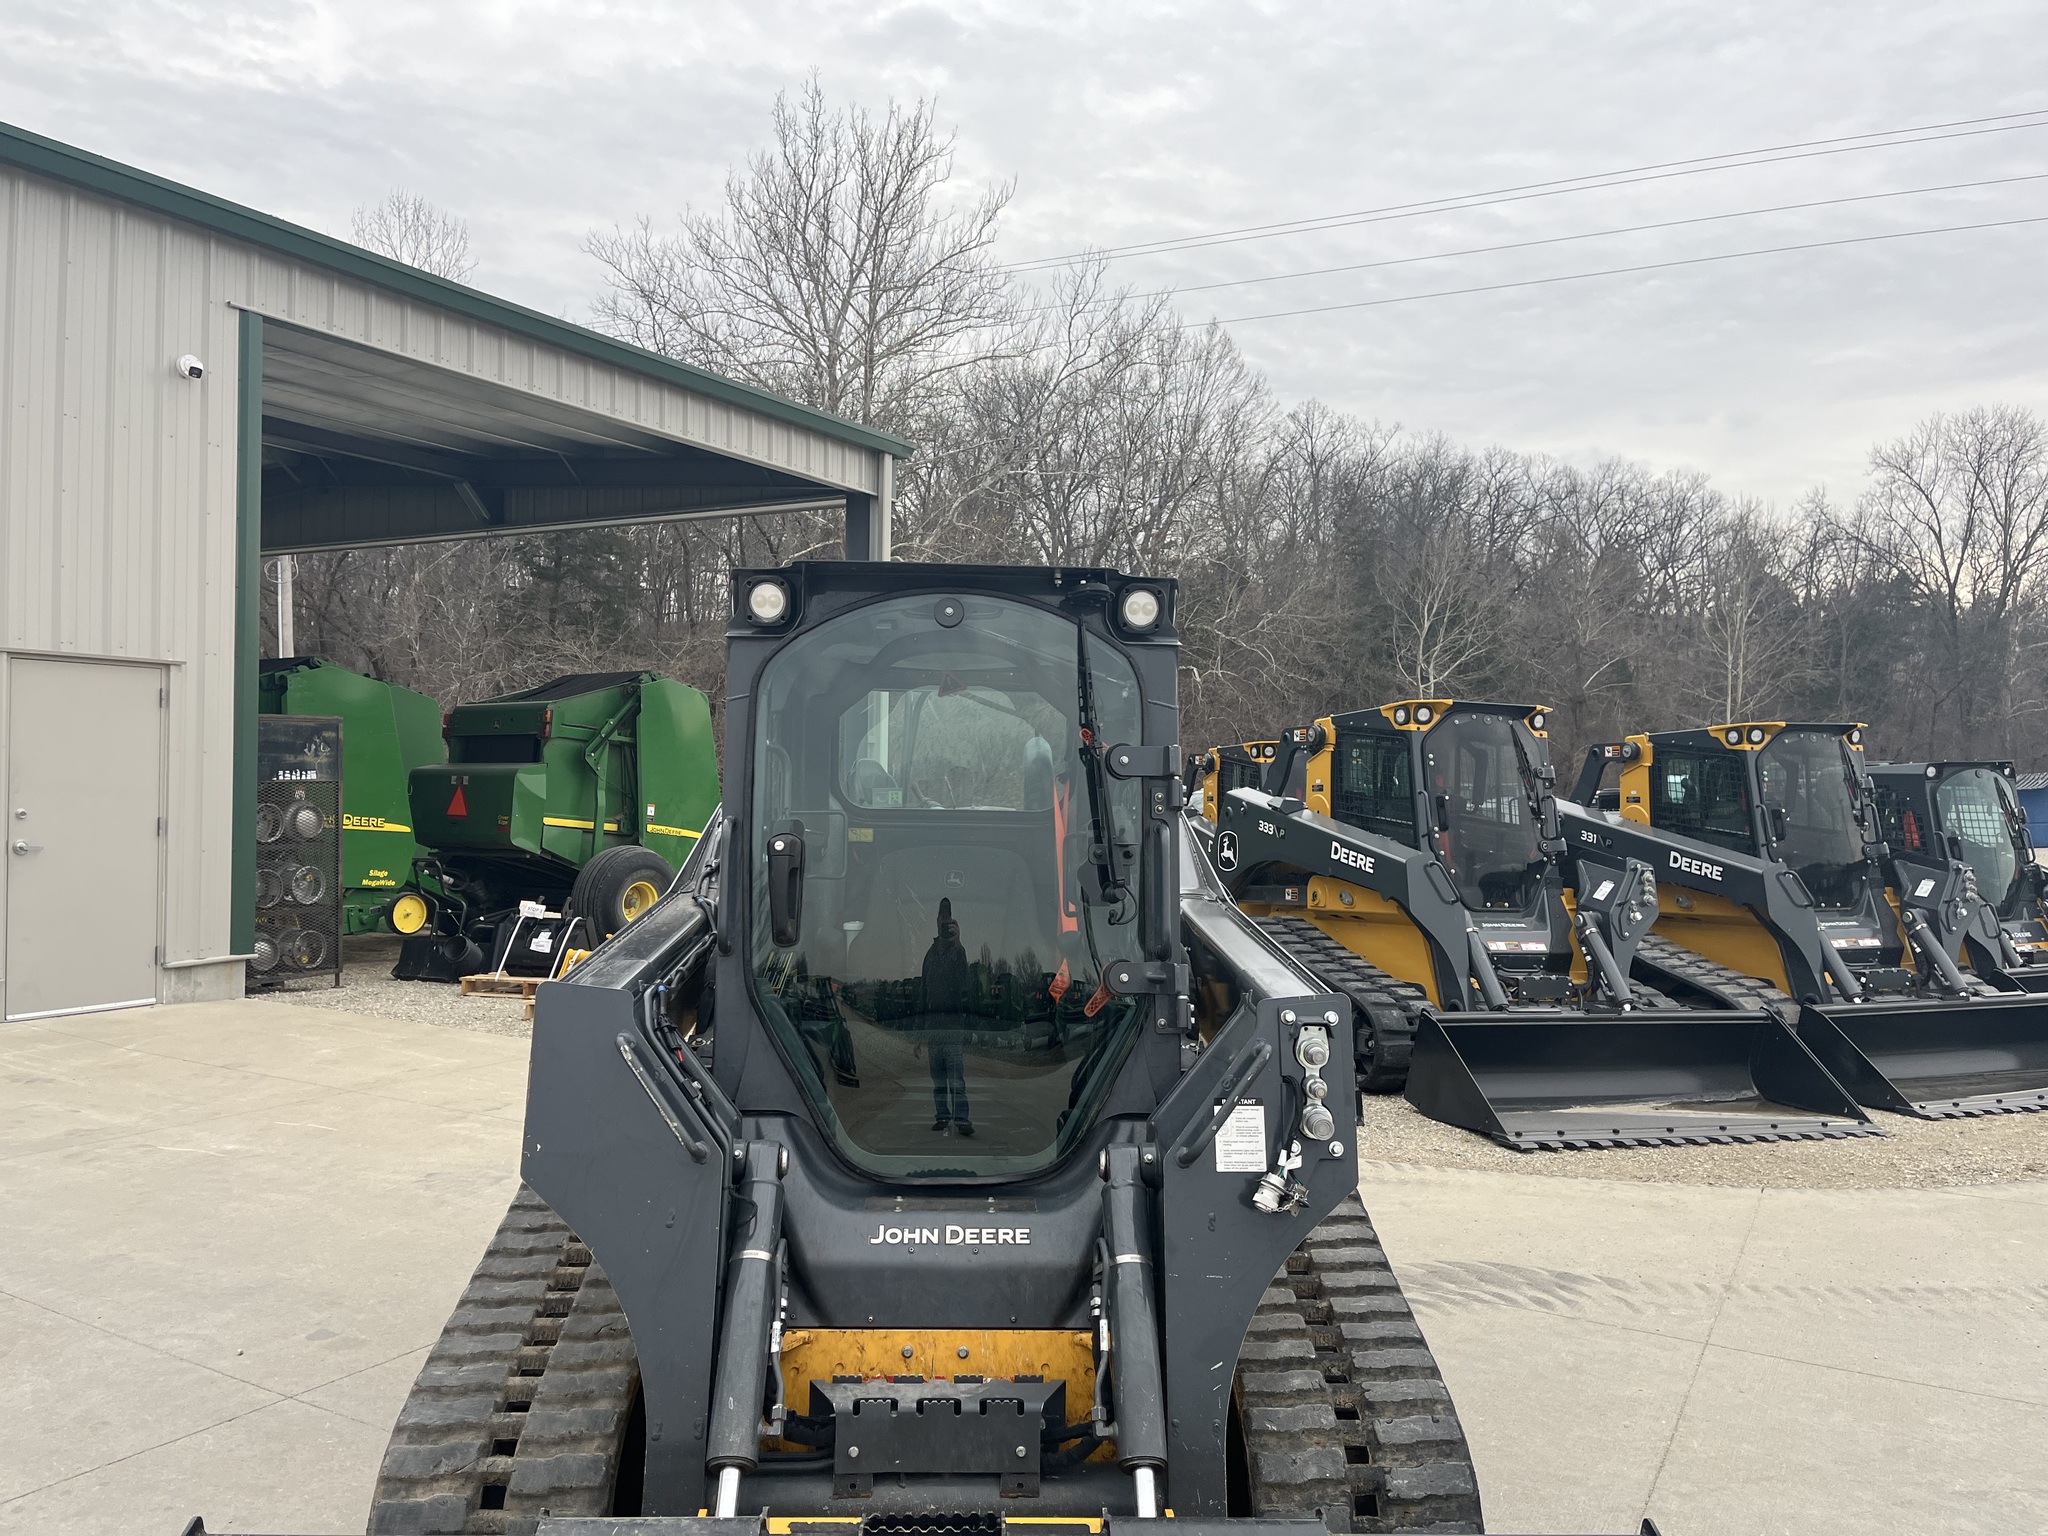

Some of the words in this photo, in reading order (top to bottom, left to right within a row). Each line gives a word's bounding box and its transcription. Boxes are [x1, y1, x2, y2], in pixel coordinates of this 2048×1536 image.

[343, 813, 386, 828] DEERE
[1258, 820, 1274, 836] 333
[1580, 830, 1597, 844] 331
[1330, 840, 1375, 874] DEERE
[1669, 850, 1724, 882] DEERE
[870, 1224, 939, 1245] JOHN
[945, 1224, 1031, 1245] DEERE
